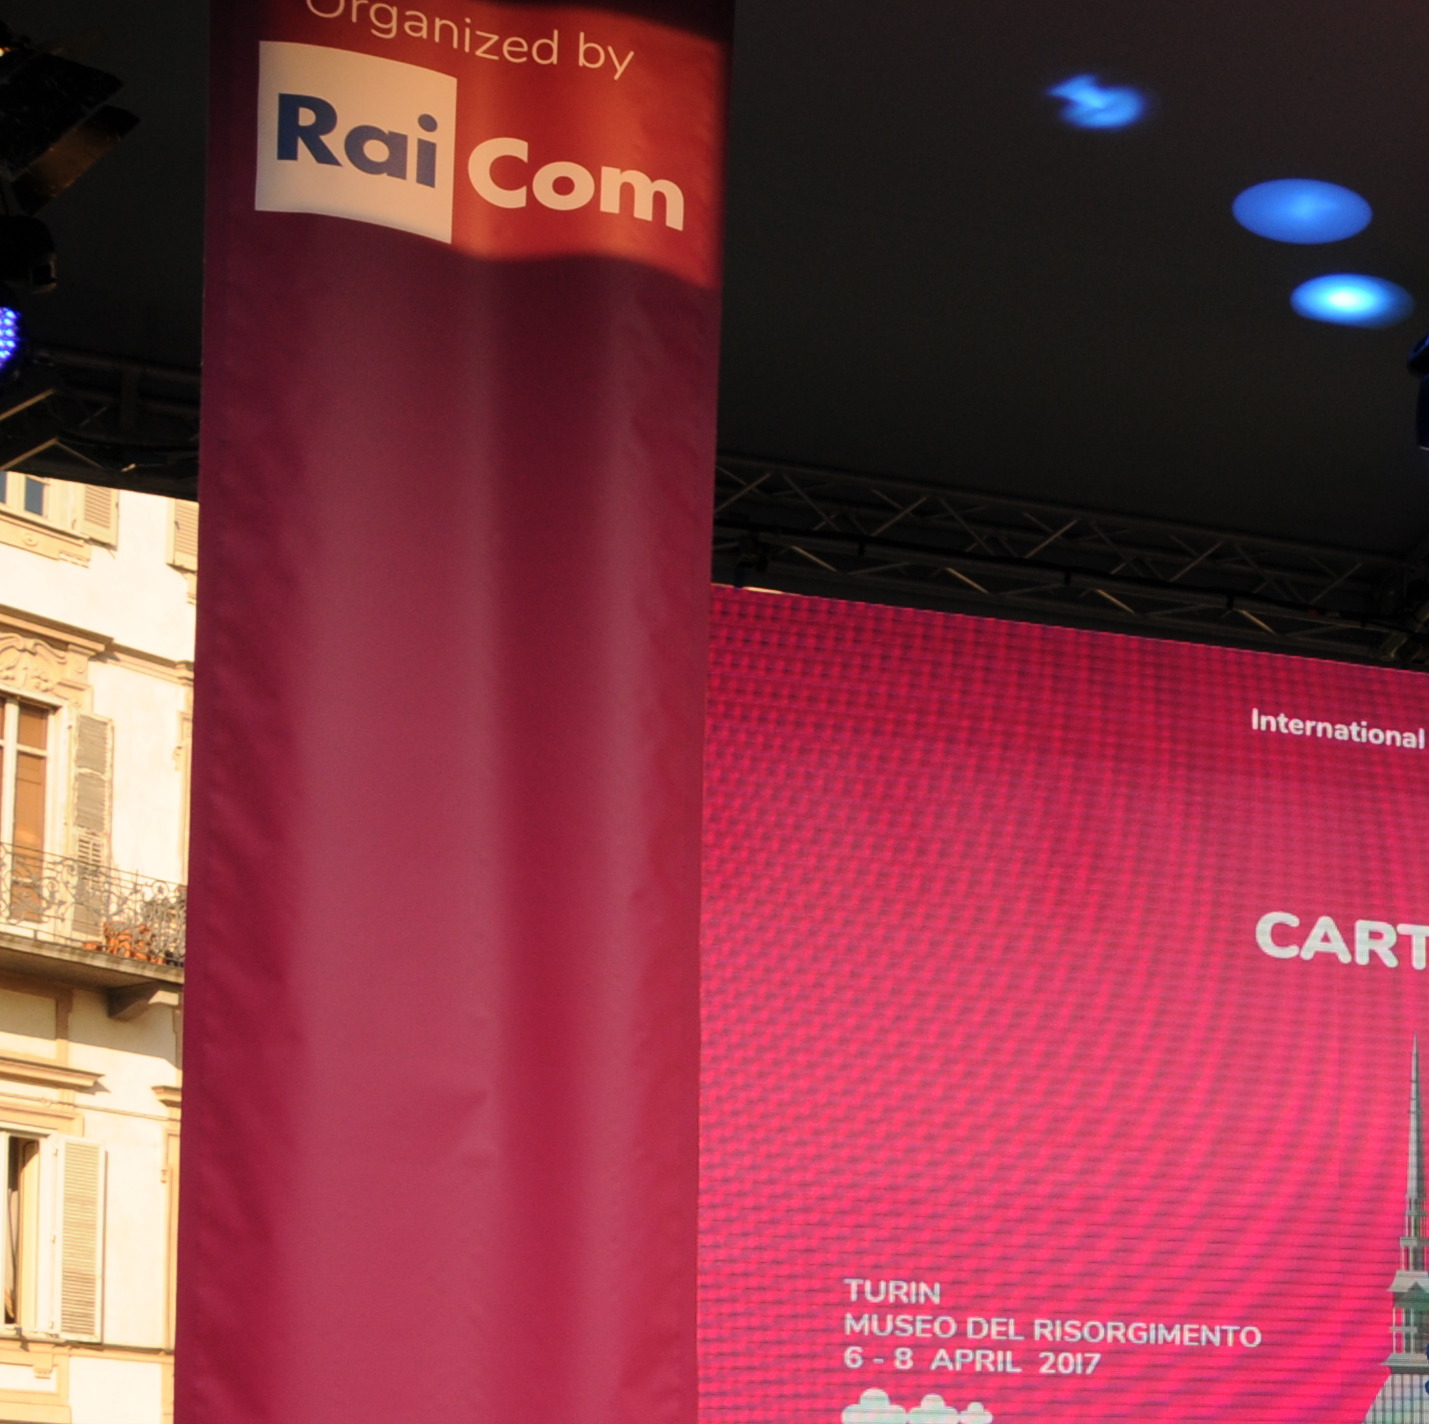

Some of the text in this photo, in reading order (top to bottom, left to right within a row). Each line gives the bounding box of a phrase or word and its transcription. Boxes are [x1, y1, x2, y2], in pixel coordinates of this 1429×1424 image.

[577, 32, 634, 80] by
[276, 92, 685, 231] Rai Com
[1251, 708, 1425, 750] International
[843, 1278, 941, 1305] TURIN
[844, 1314, 1262, 1348] MUSEO DEL RISORGIMENTO
[843, 1346, 863, 1369] 6
[894, 1347, 914, 1370] 8
[931, 1349, 1022, 1373] APRIL
[1038, 1352, 1102, 1375] 2017
